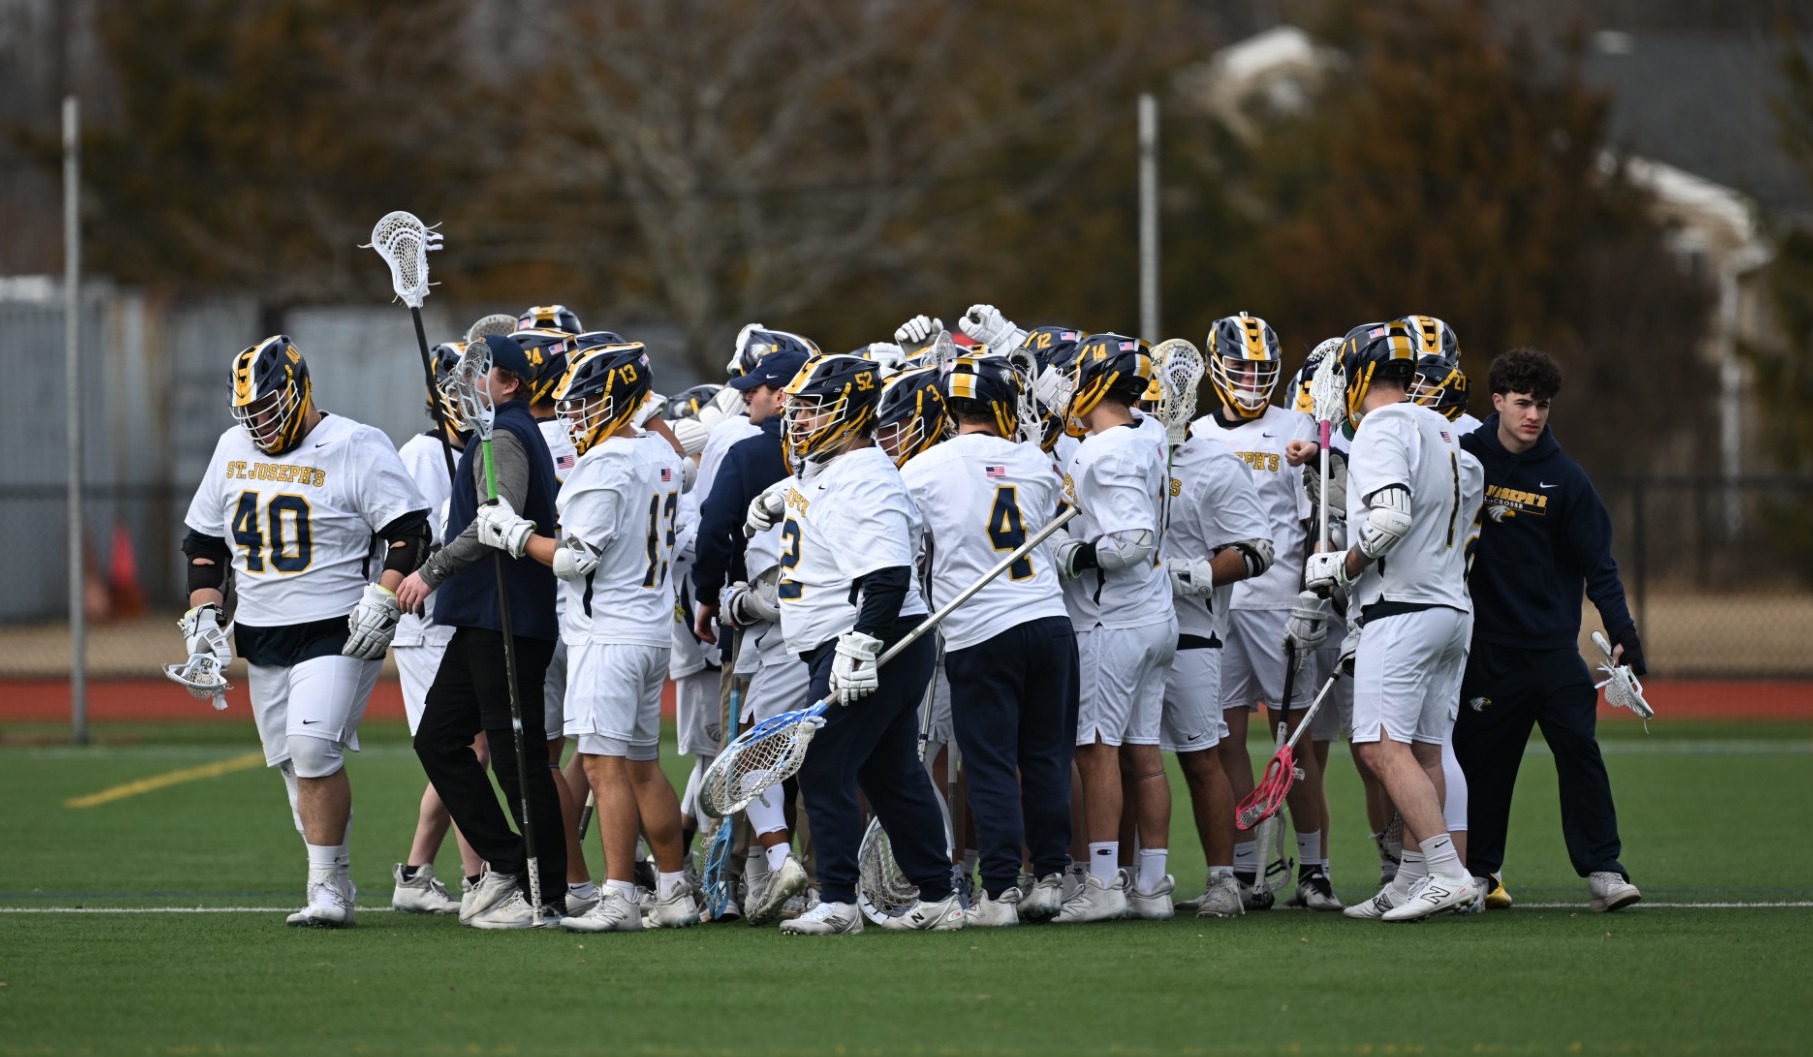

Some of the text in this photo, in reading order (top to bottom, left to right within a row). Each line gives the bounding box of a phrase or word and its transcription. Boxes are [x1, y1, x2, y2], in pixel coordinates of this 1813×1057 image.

[1037, 332, 1052, 349] 12
[1092, 343, 1107, 361] 14
[618, 363, 638, 385] 13
[854, 371, 875, 391] 52
[1453, 373, 1467, 392] 27
[231, 489, 313, 575] 40
[984, 484, 1038, 582] 4
